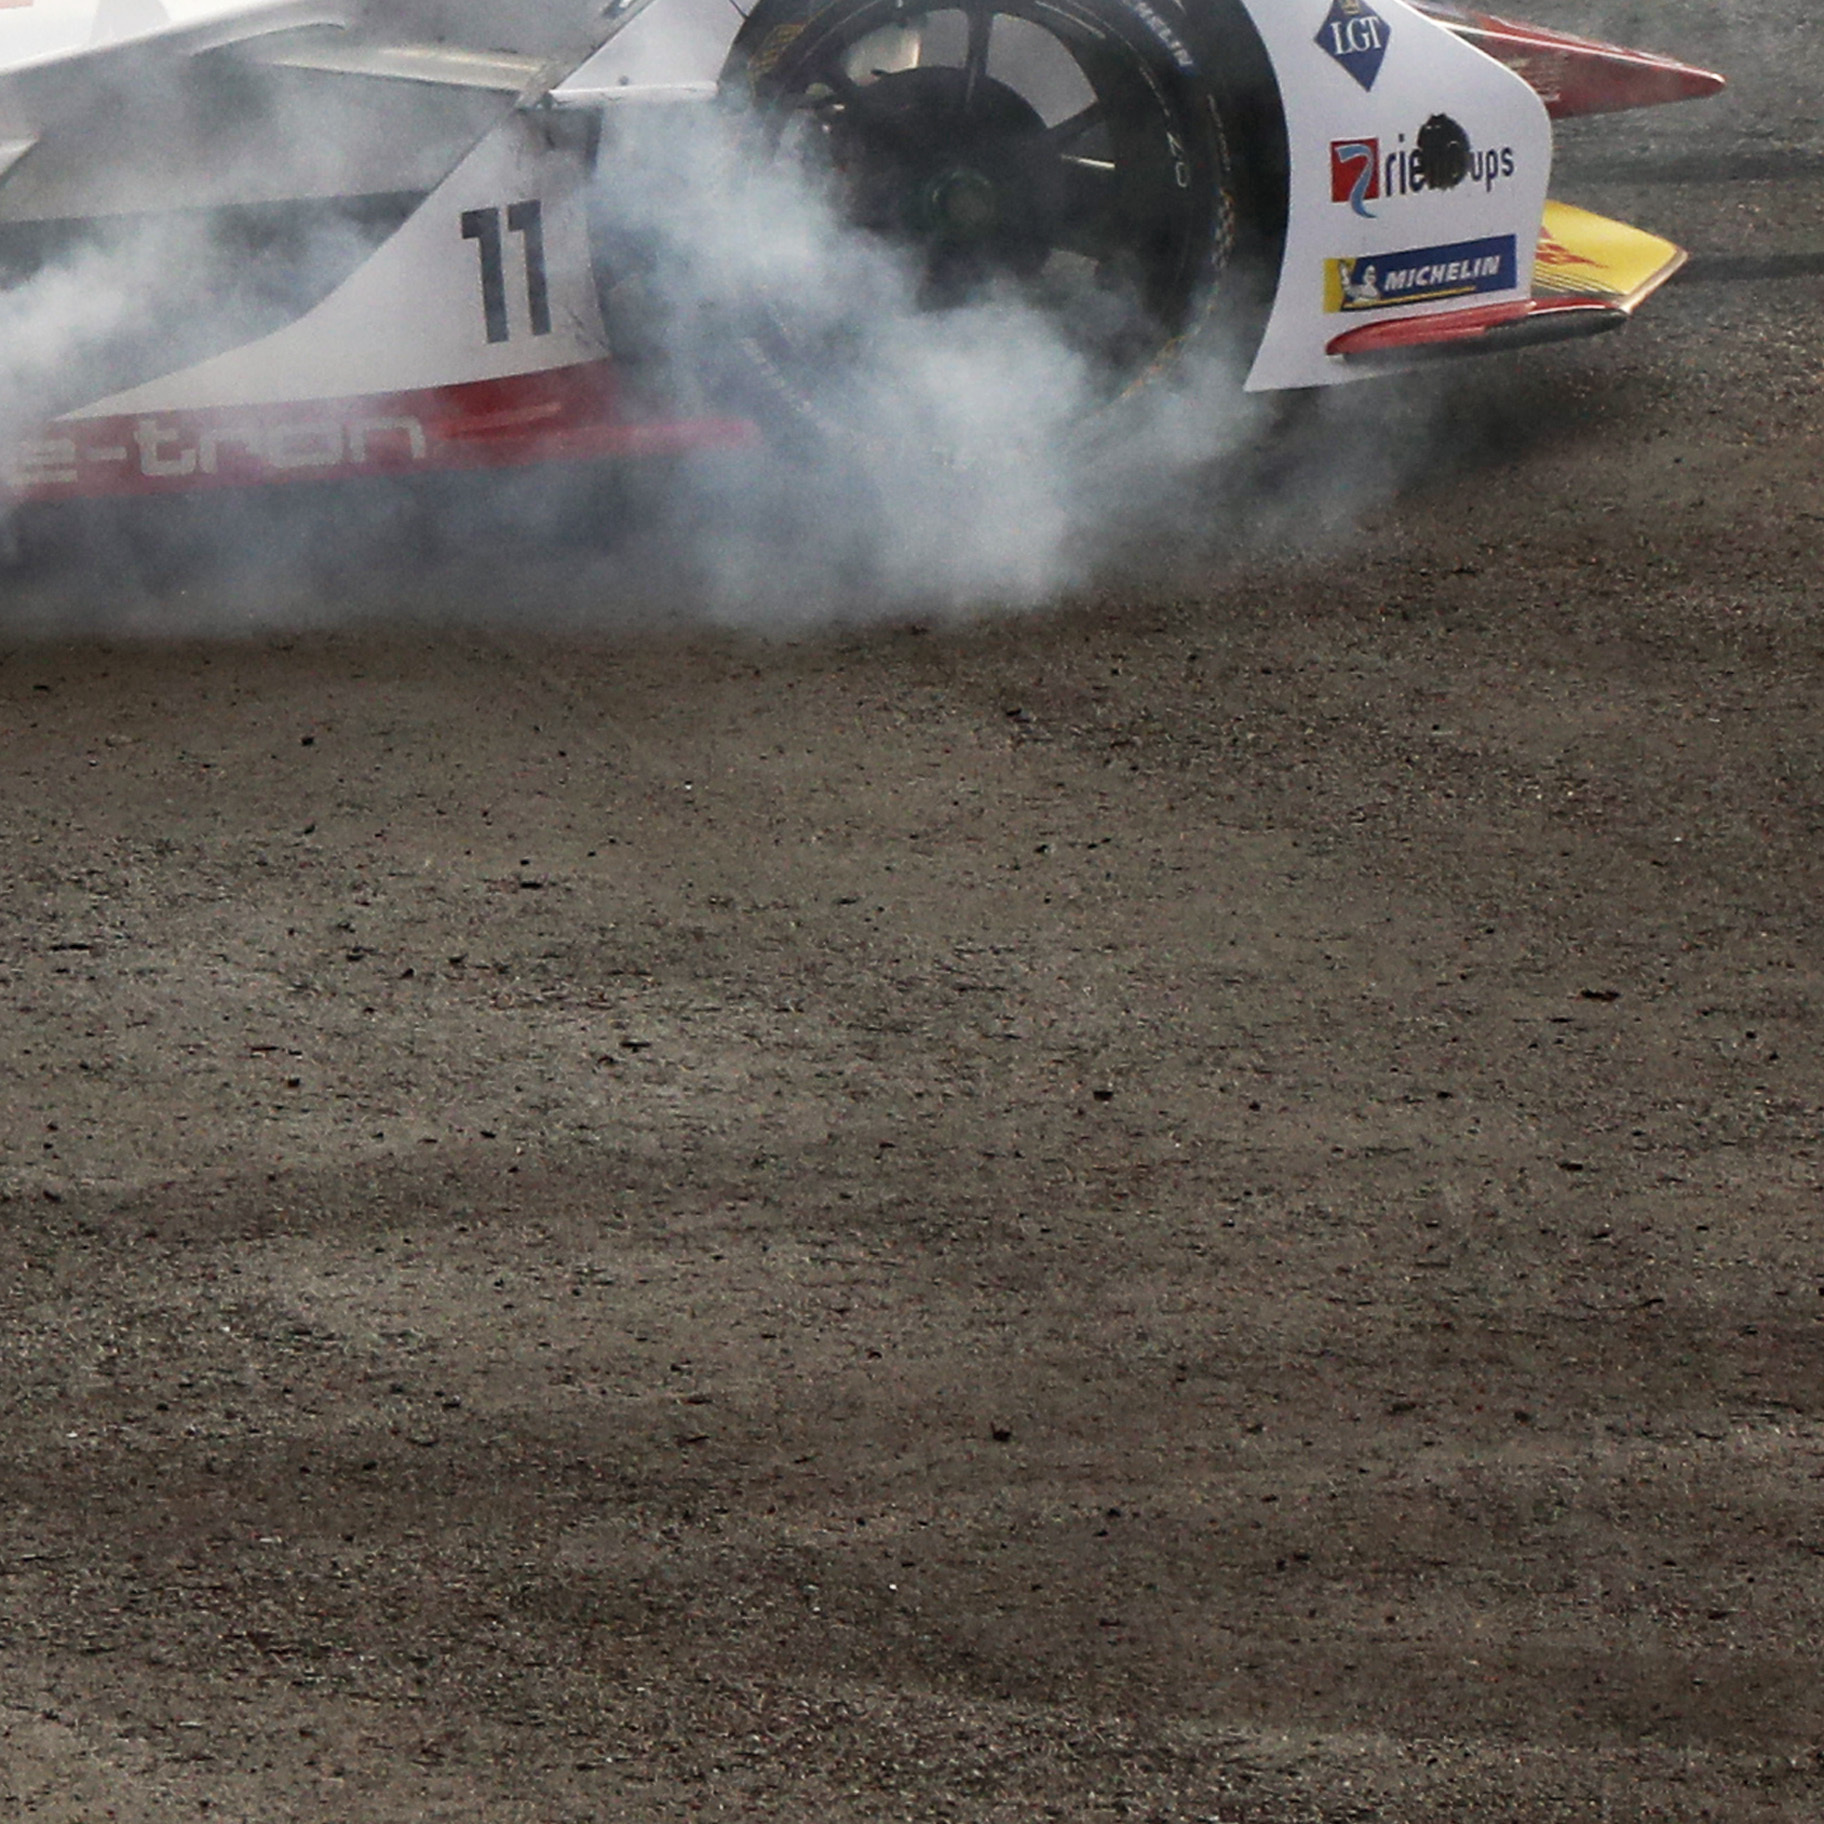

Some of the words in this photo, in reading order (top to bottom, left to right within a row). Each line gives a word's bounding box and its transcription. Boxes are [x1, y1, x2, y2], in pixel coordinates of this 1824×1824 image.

[1329, 15, 1383, 56] LGT
[459, 198, 553, 345] 11
[1382, 254, 1502, 292] MICHELIN
